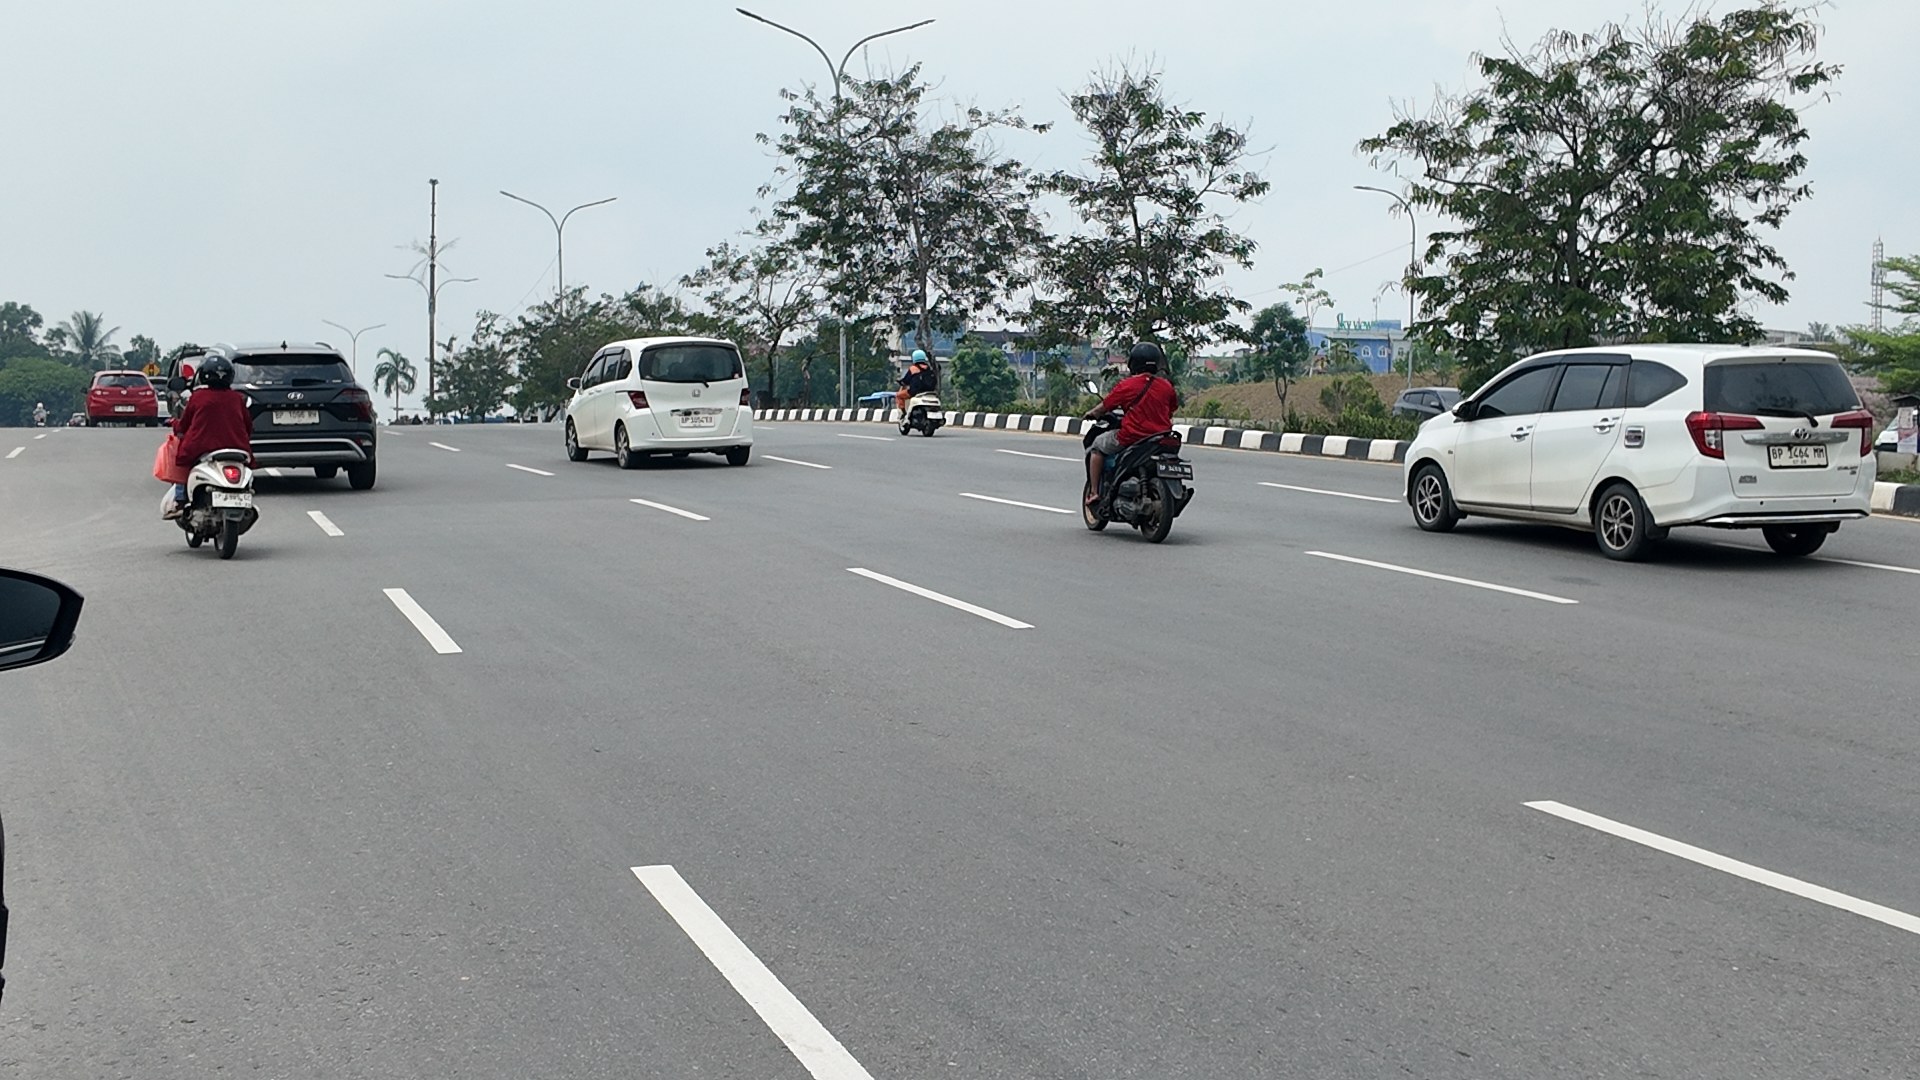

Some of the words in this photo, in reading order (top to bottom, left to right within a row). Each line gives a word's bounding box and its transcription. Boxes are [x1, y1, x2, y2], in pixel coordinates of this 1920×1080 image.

[1772, 448, 1783, 460] BP
[1788, 447, 1809, 459] 1464
[1813, 447, 1825, 459] MM
